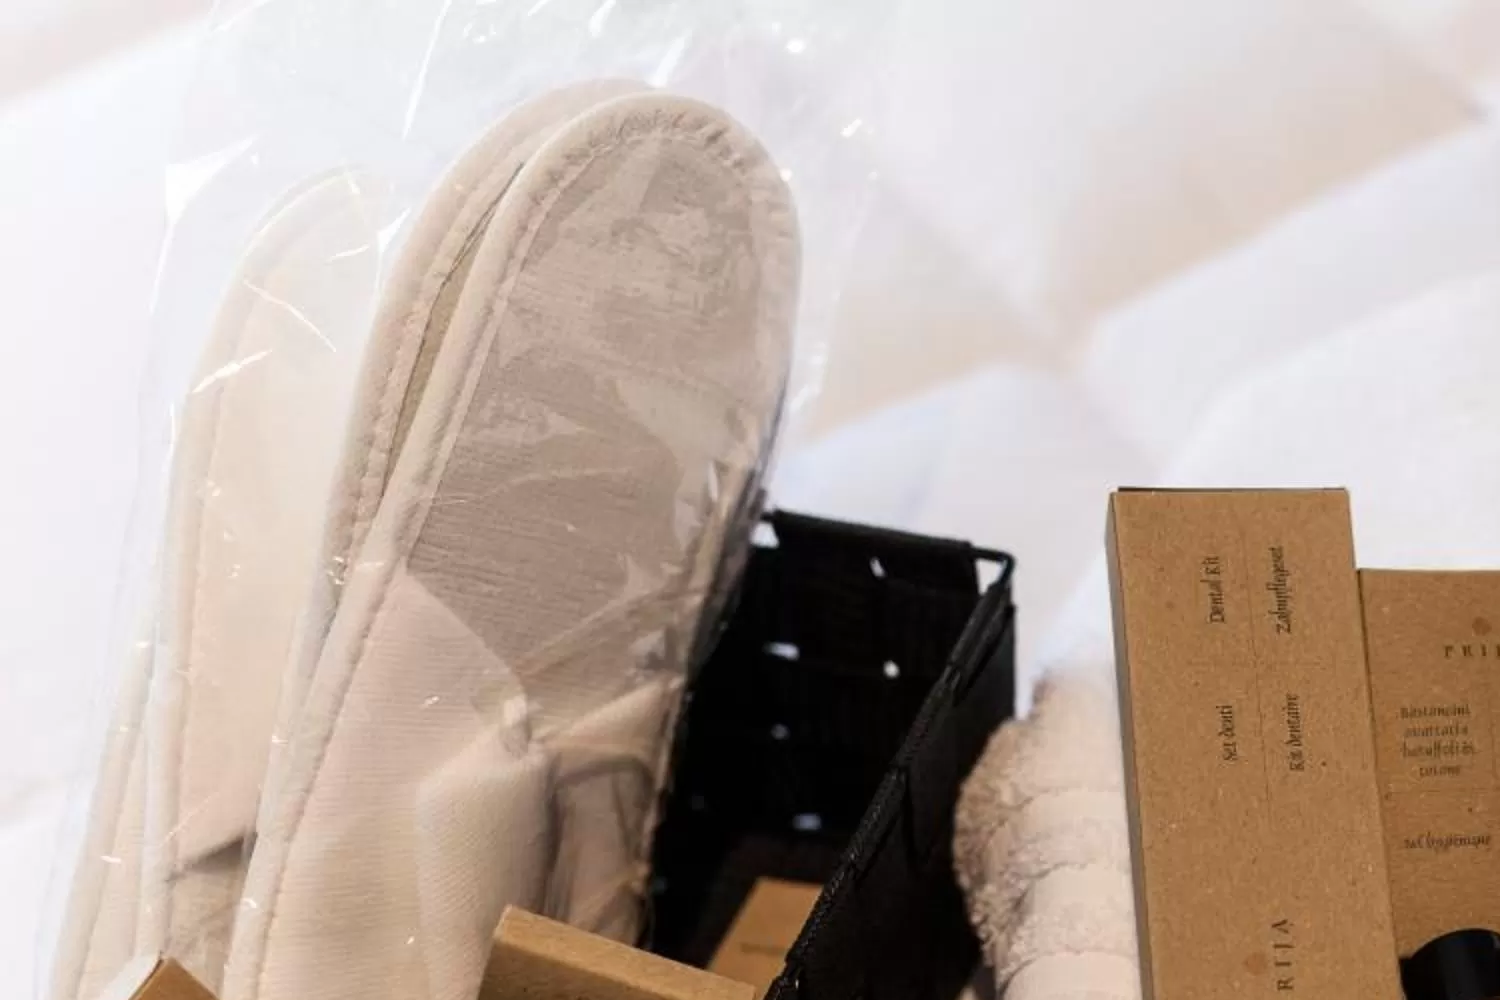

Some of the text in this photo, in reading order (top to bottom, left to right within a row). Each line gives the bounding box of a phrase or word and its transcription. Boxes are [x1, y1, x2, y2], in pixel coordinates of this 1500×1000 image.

[1200, 556, 1225, 623] Dental Kit
[1215, 705, 1238, 761] Set denti
